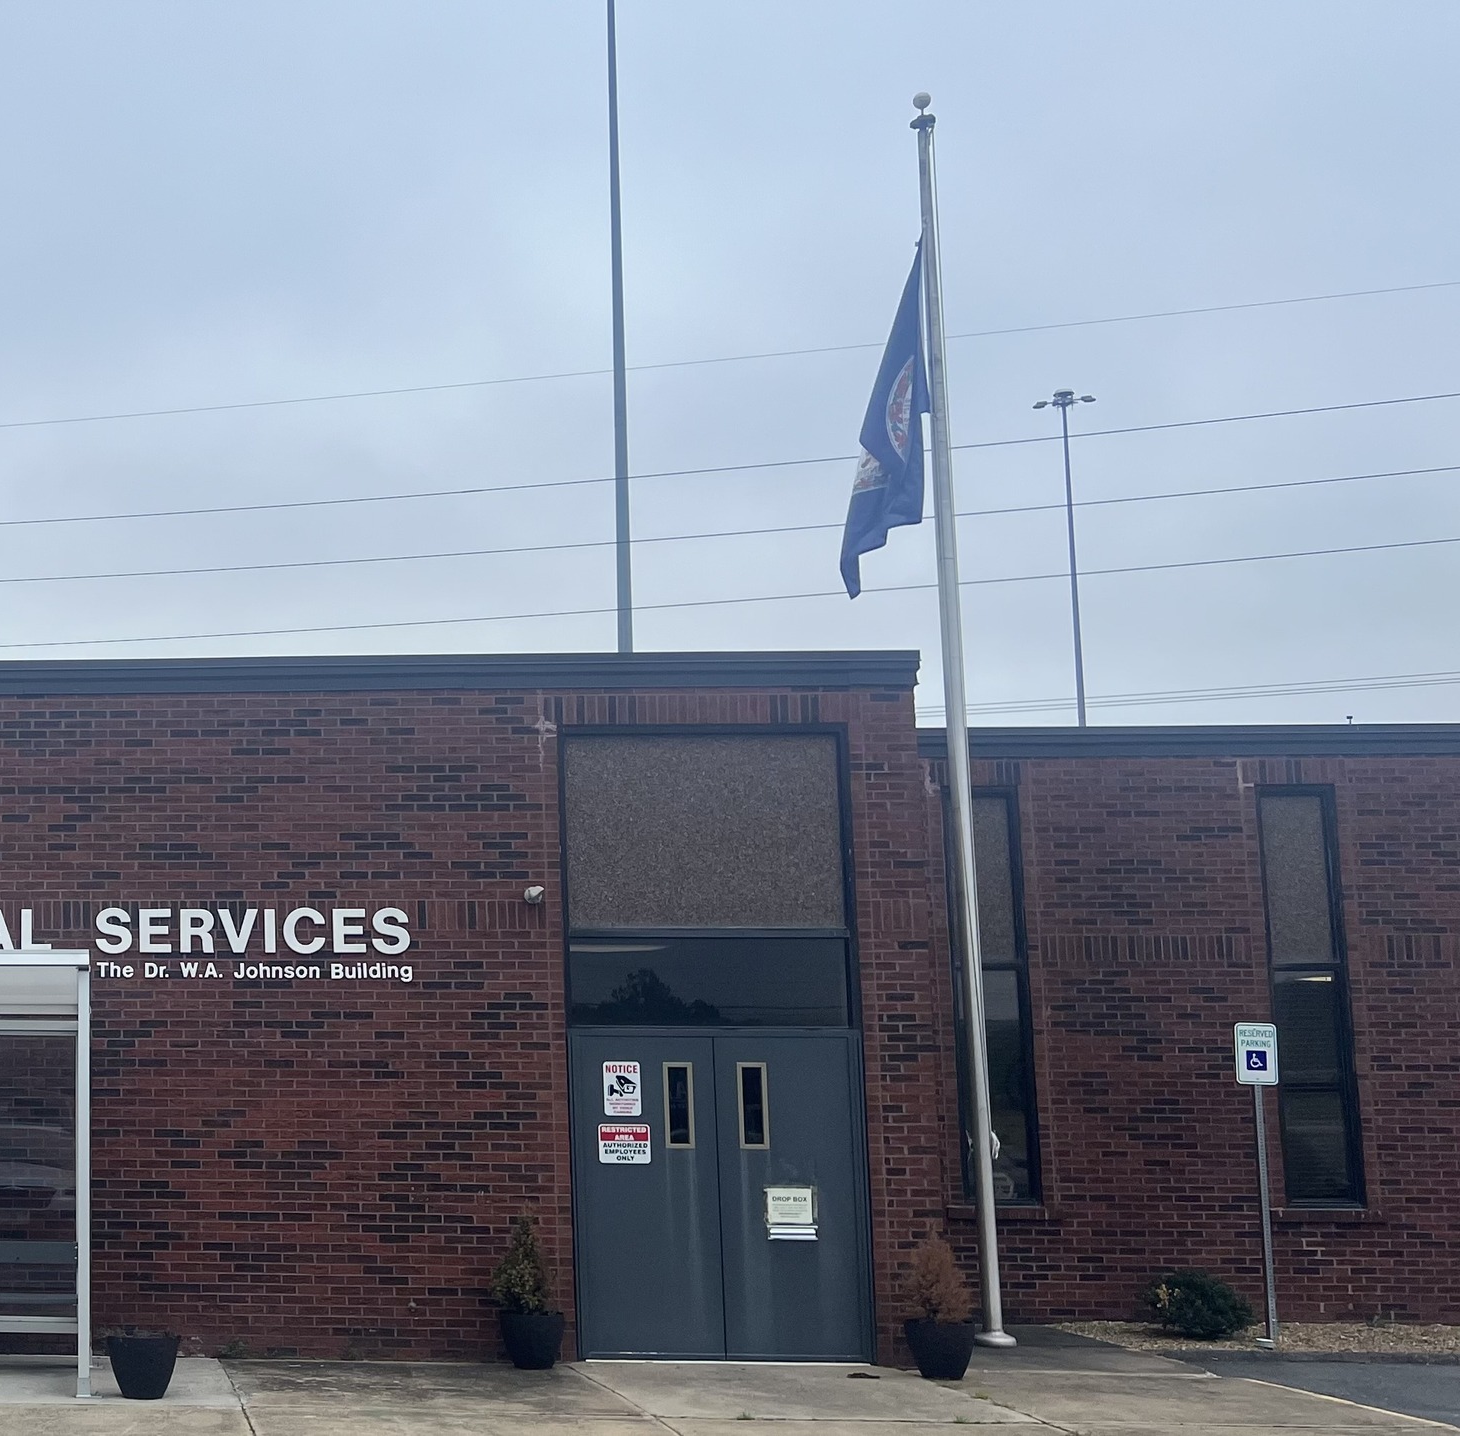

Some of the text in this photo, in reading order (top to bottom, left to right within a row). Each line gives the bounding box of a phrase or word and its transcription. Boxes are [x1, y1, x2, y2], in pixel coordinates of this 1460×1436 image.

[95, 907, 411, 954] SERVICES
[97, 962, 414, 982] The Dr. W.A. Johnson Building
[1239, 1029, 1273, 1038] RESERVED
[1241, 1039, 1271, 1048] PARKING
[605, 1065, 638, 1073] NOTICE
